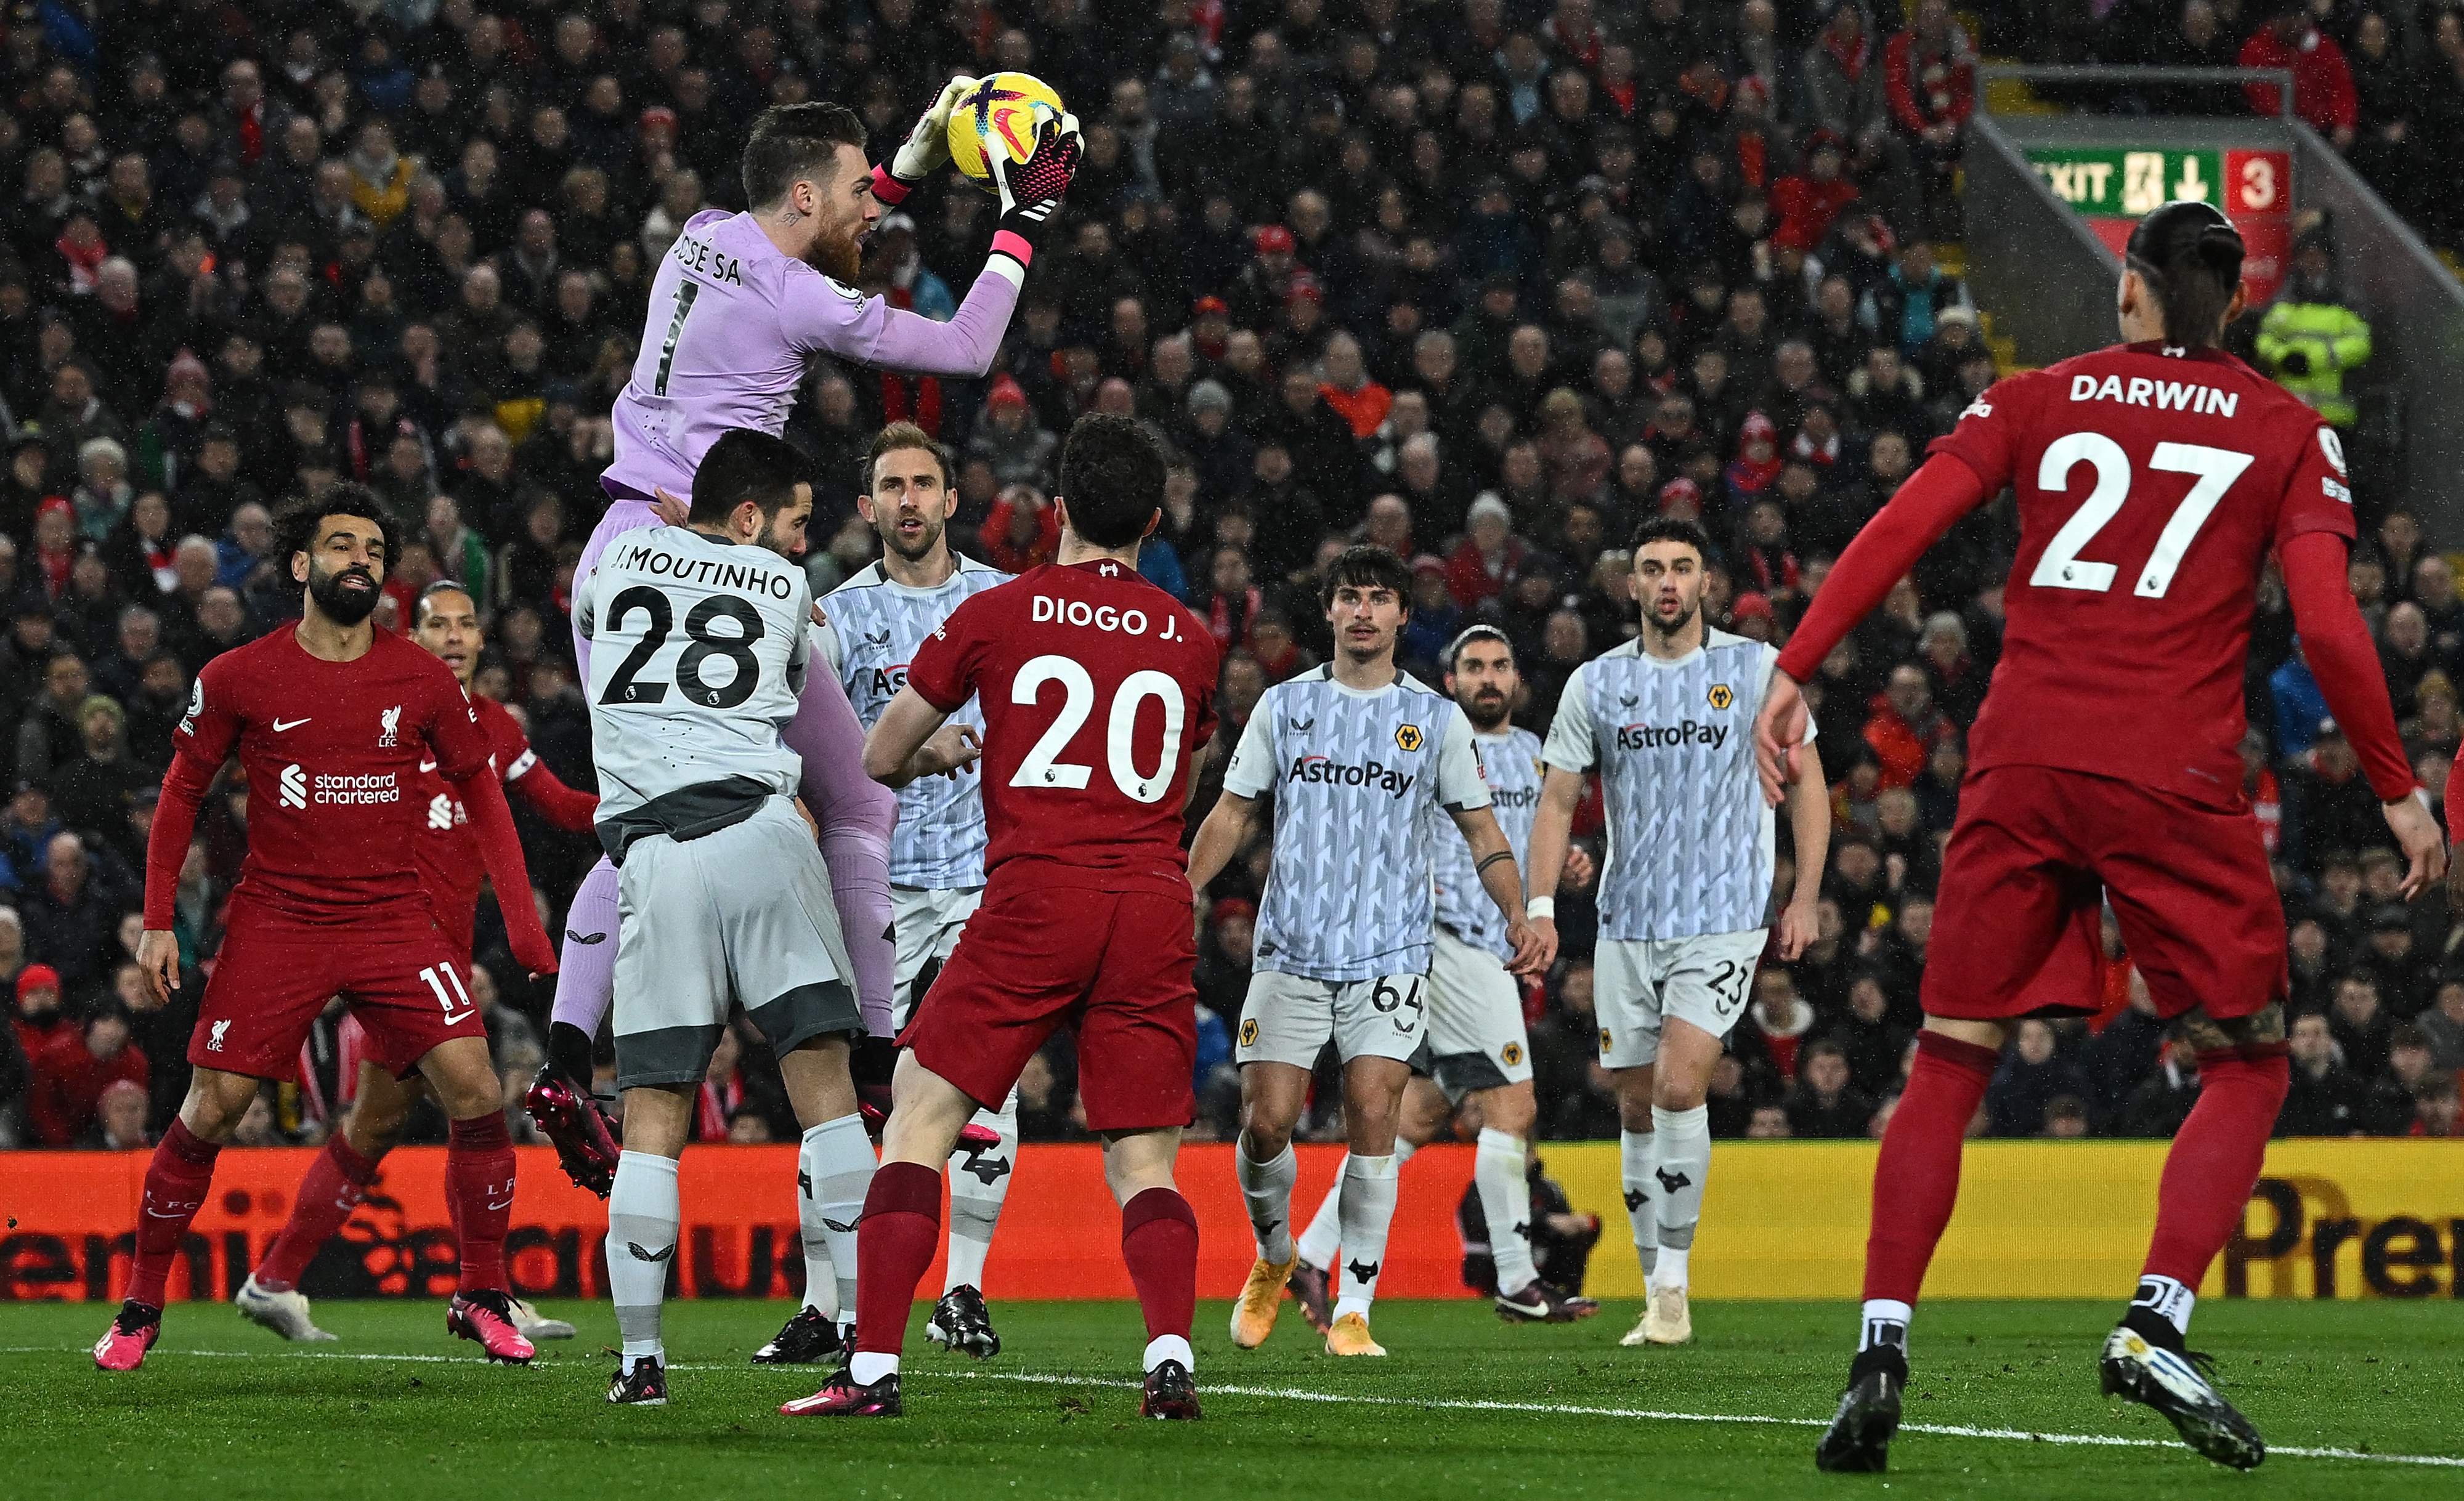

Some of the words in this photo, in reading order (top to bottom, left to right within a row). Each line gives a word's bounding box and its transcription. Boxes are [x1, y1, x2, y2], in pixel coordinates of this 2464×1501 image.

[2033, 163, 2114, 203] XIT
[2241, 158, 2276, 209] 3
[713, 253, 741, 286] SA
[655, 278, 700, 398] 1
[2069, 374, 2239, 418] DARWIN
[2028, 432, 2255, 599] 27
[1032, 595, 1148, 636] DIOGO
[1159, 615, 1183, 642] J.
[597, 585, 765, 709] 28
[1008, 654, 1185, 804] 20
[1616, 719, 1728, 751] AstroPay
[315, 772, 396, 789] standard
[315, 787, 400, 804] chartered
[1288, 755, 1414, 800] AstroPay
[419, 961, 471, 1011] 11
[1371, 974, 1424, 1021] 64
[1706, 959, 1748, 1005] 23
[2224, 1176, 2464, 1298] Pre
